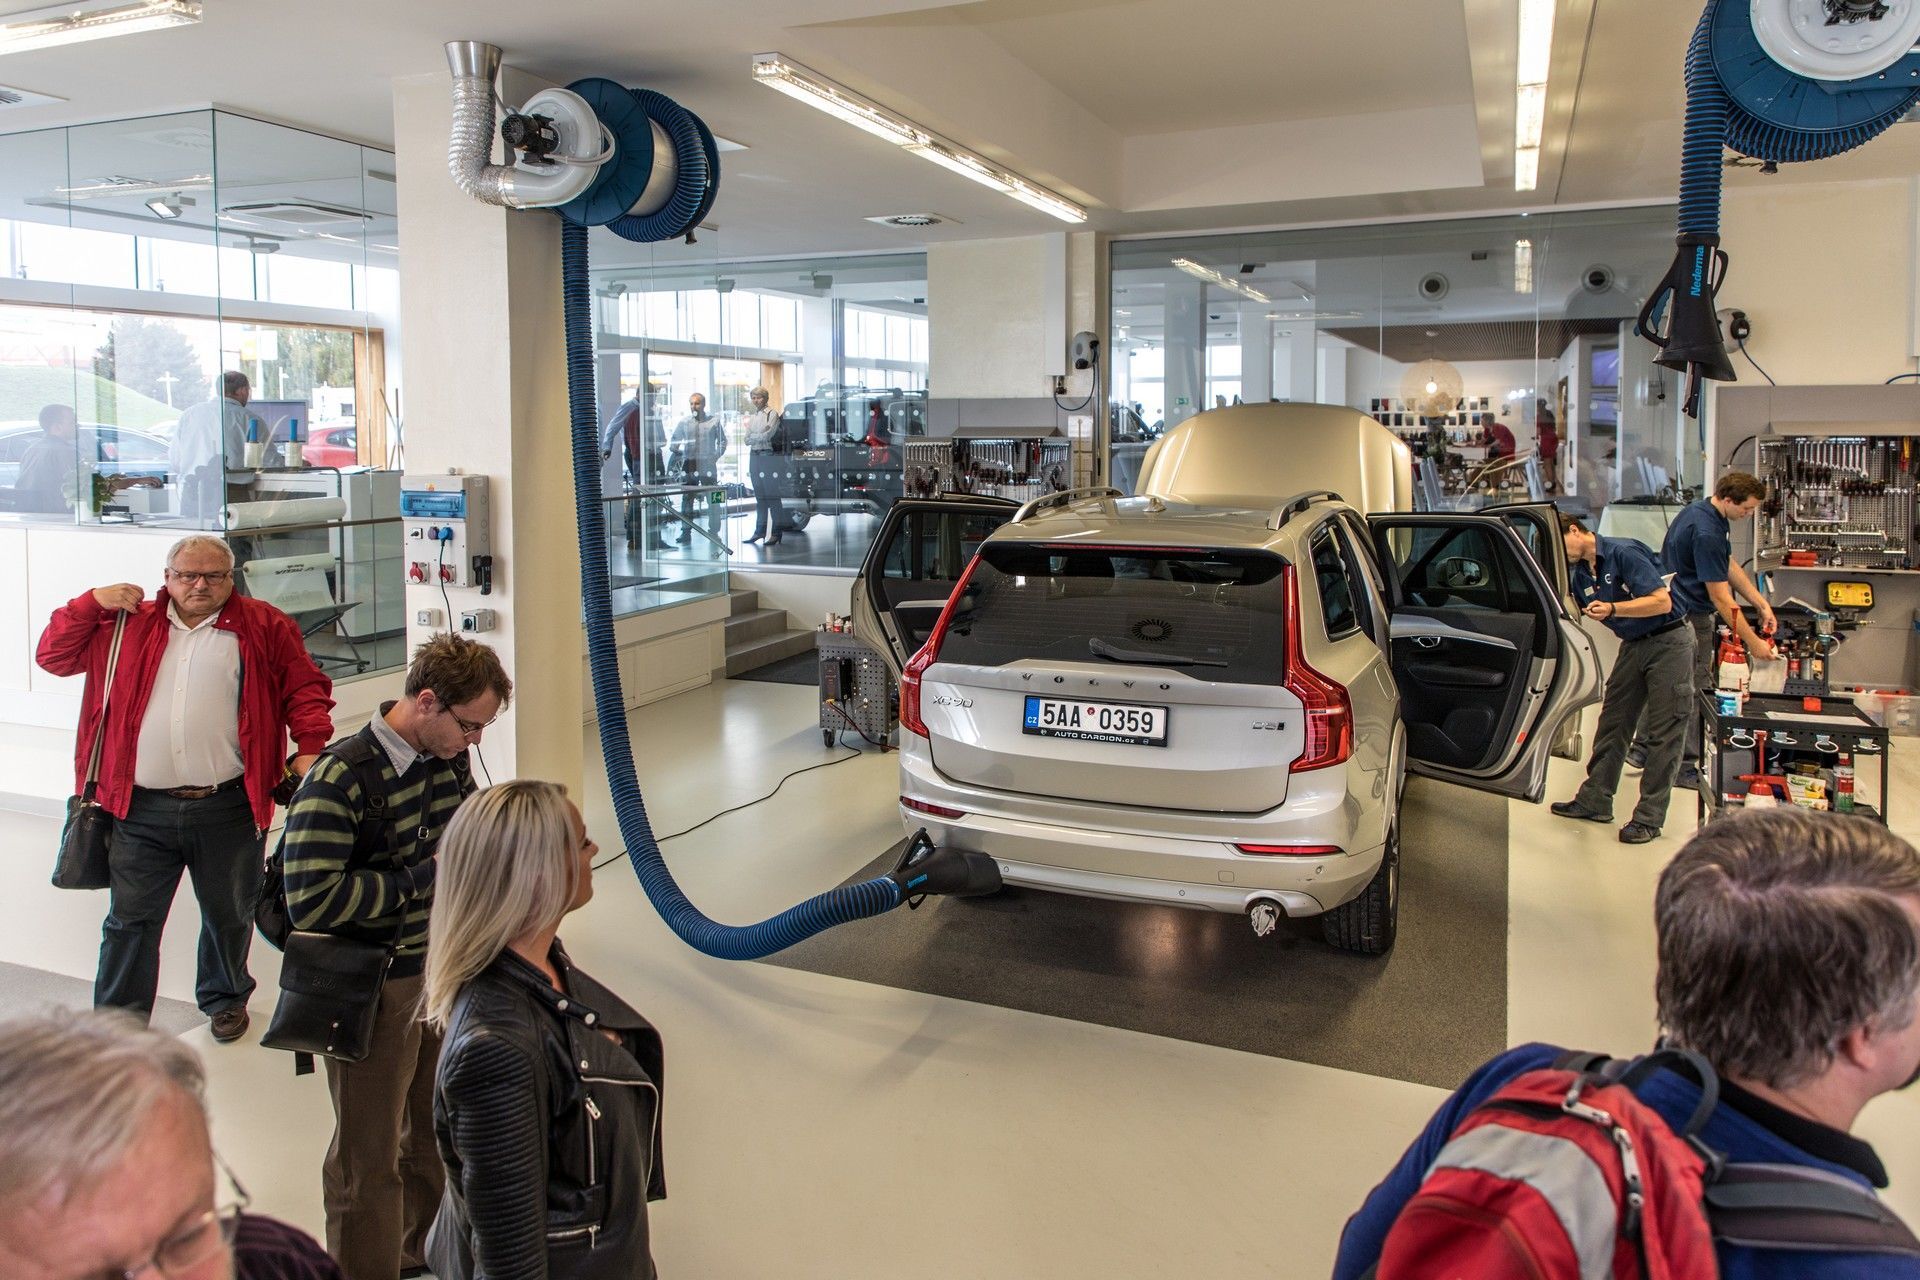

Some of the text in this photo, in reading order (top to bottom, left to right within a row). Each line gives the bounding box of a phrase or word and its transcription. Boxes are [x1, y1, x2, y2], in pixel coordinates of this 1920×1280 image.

[1690, 245, 1704, 296] Nederma
[1022, 673, 1171, 690] VOLVO
[1027, 716, 1037, 724] CZ
[1043, 703, 1153, 734] 5AA 0359
[1055, 731, 1135, 744] AUTO CARDION.cz
